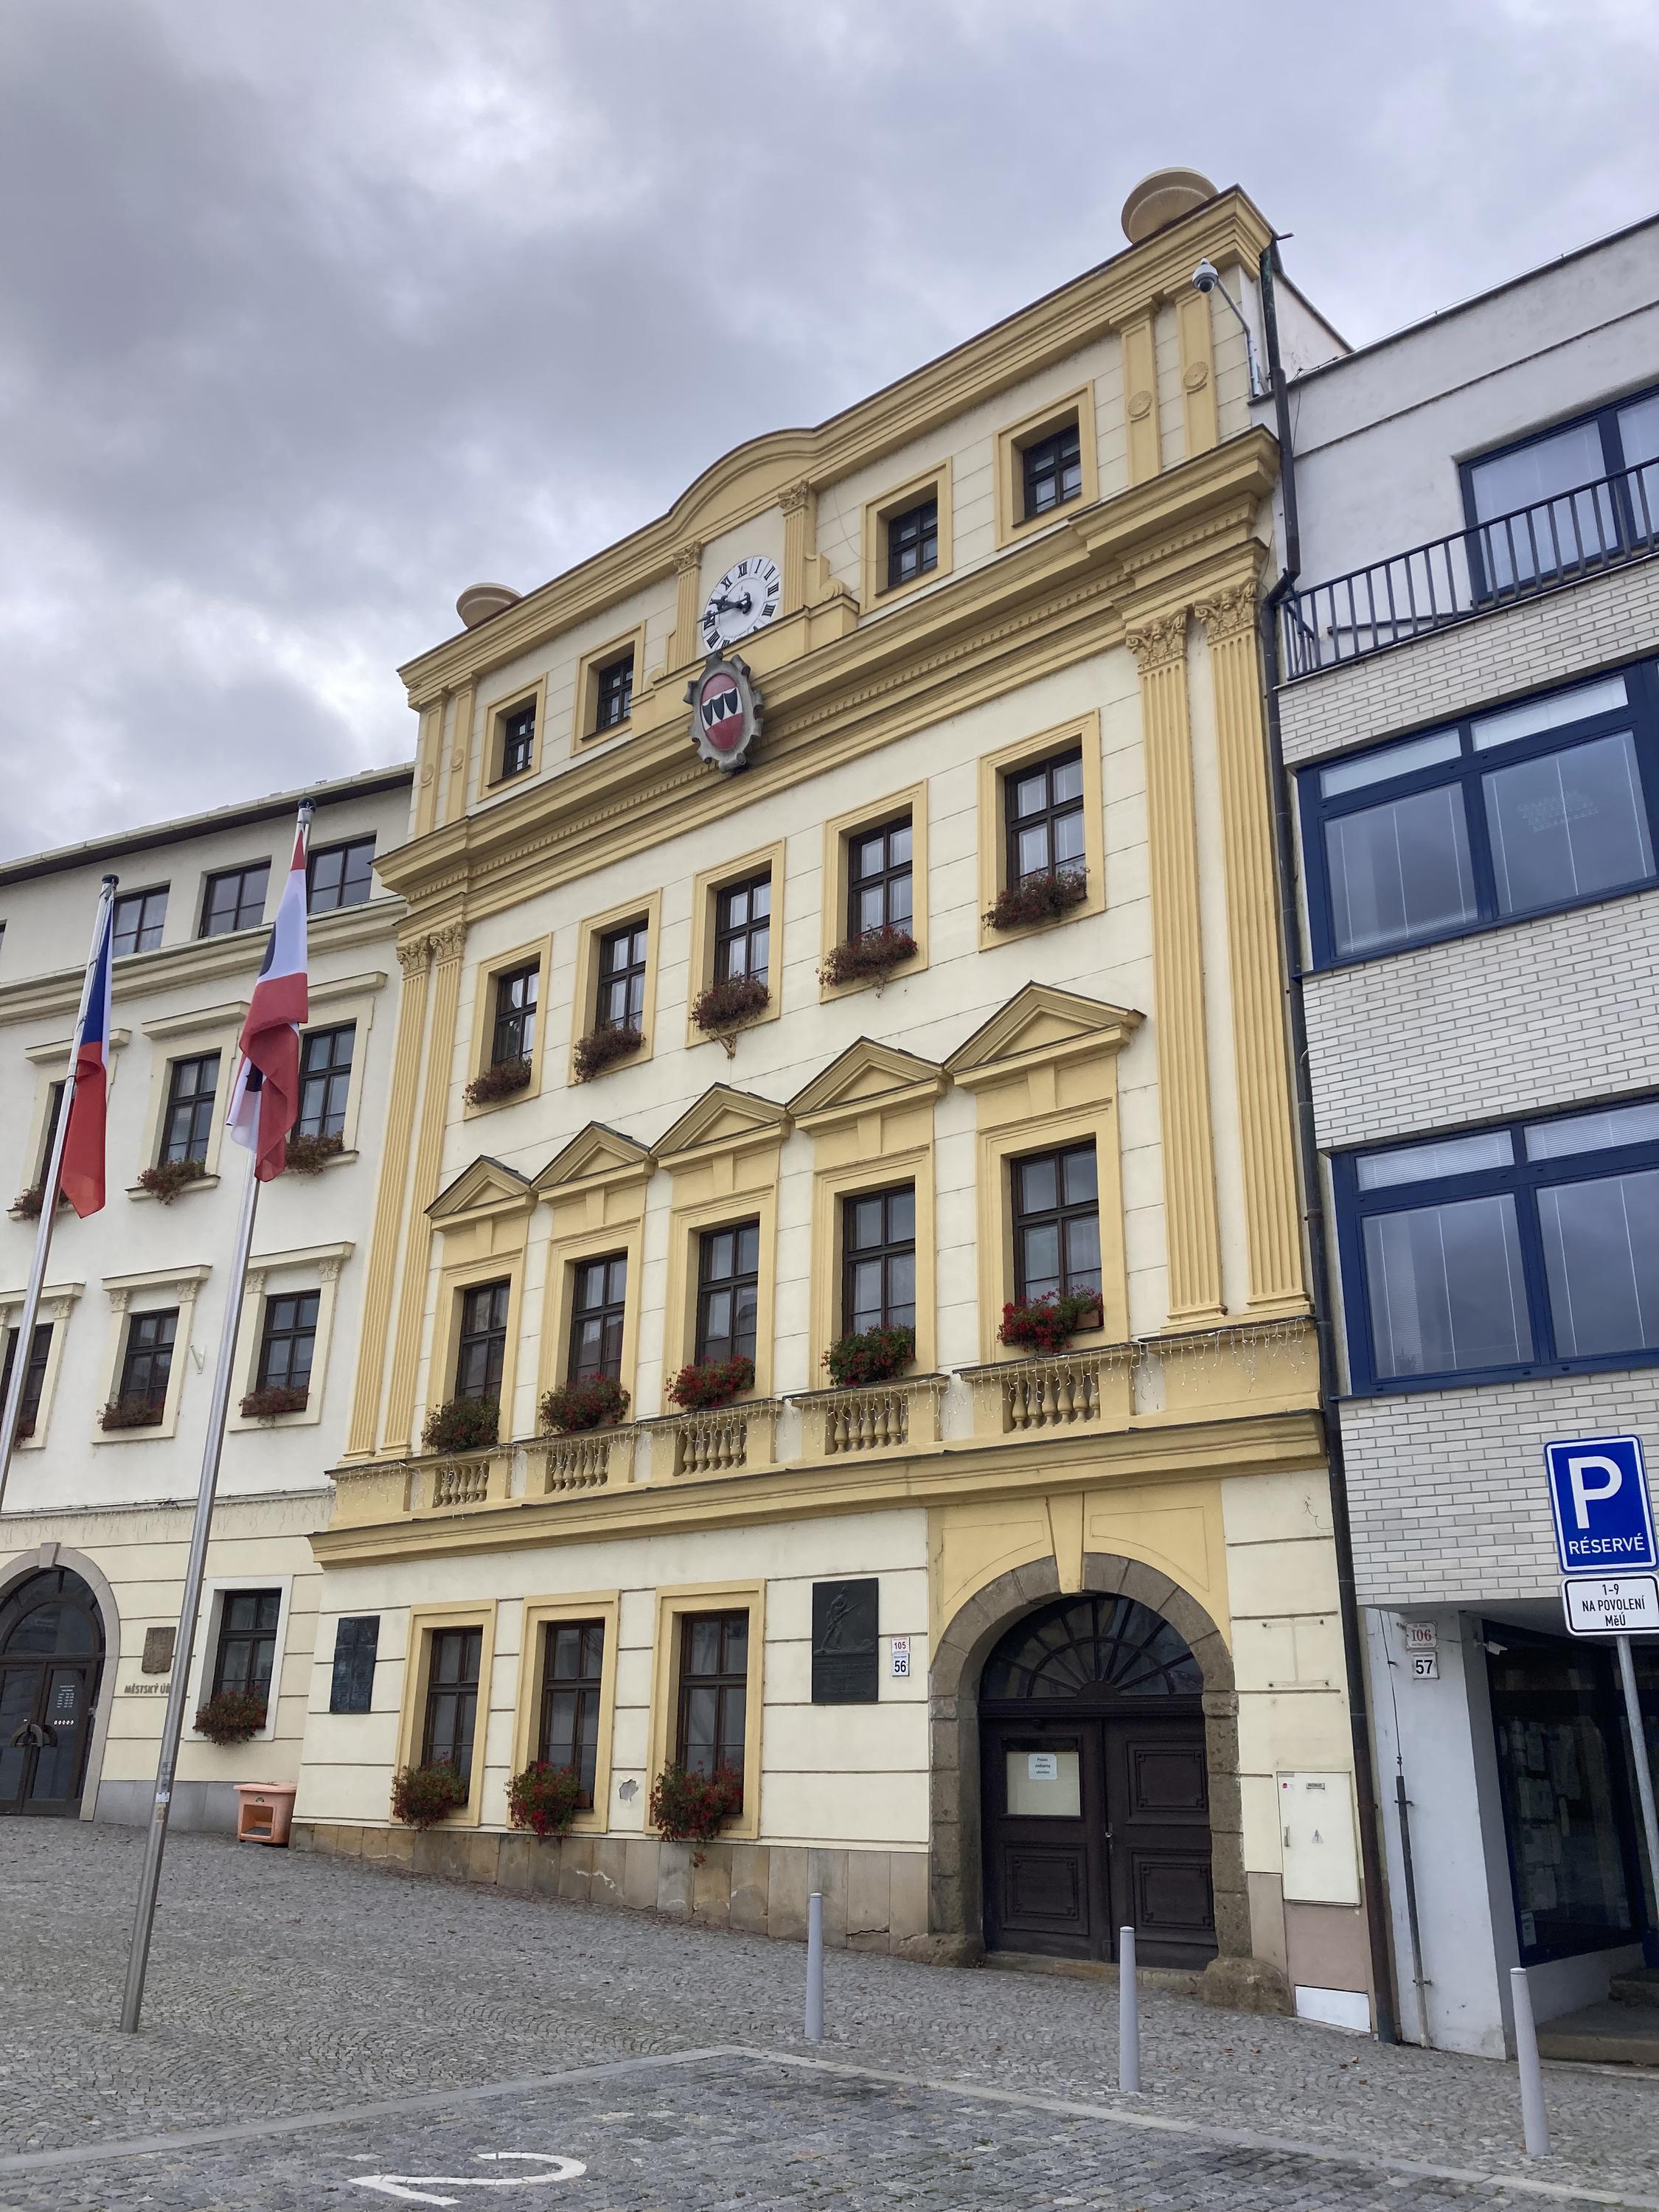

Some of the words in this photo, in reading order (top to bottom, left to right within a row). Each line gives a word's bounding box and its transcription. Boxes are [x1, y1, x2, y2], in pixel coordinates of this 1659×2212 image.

[737, 561, 748, 578] XII
[720, 575, 733, 591] XI
[1568, 1455, 1623, 1529] P
[1568, 1533, 1645, 1554] RÉSERVÉ
[1582, 1600, 1596, 1612] NA
[1598, 1595, 1646, 1612] POVOLENÍ
[1605, 1612, 1627, 1627] MěÚ
[1411, 1629, 1432, 1641] 106
[894, 1641, 905, 1649] 105
[894, 1660, 906, 1672] 56
[1416, 1660, 1433, 1674] 57
[124, 1683, 159, 1694] MĚSTSKÝ
